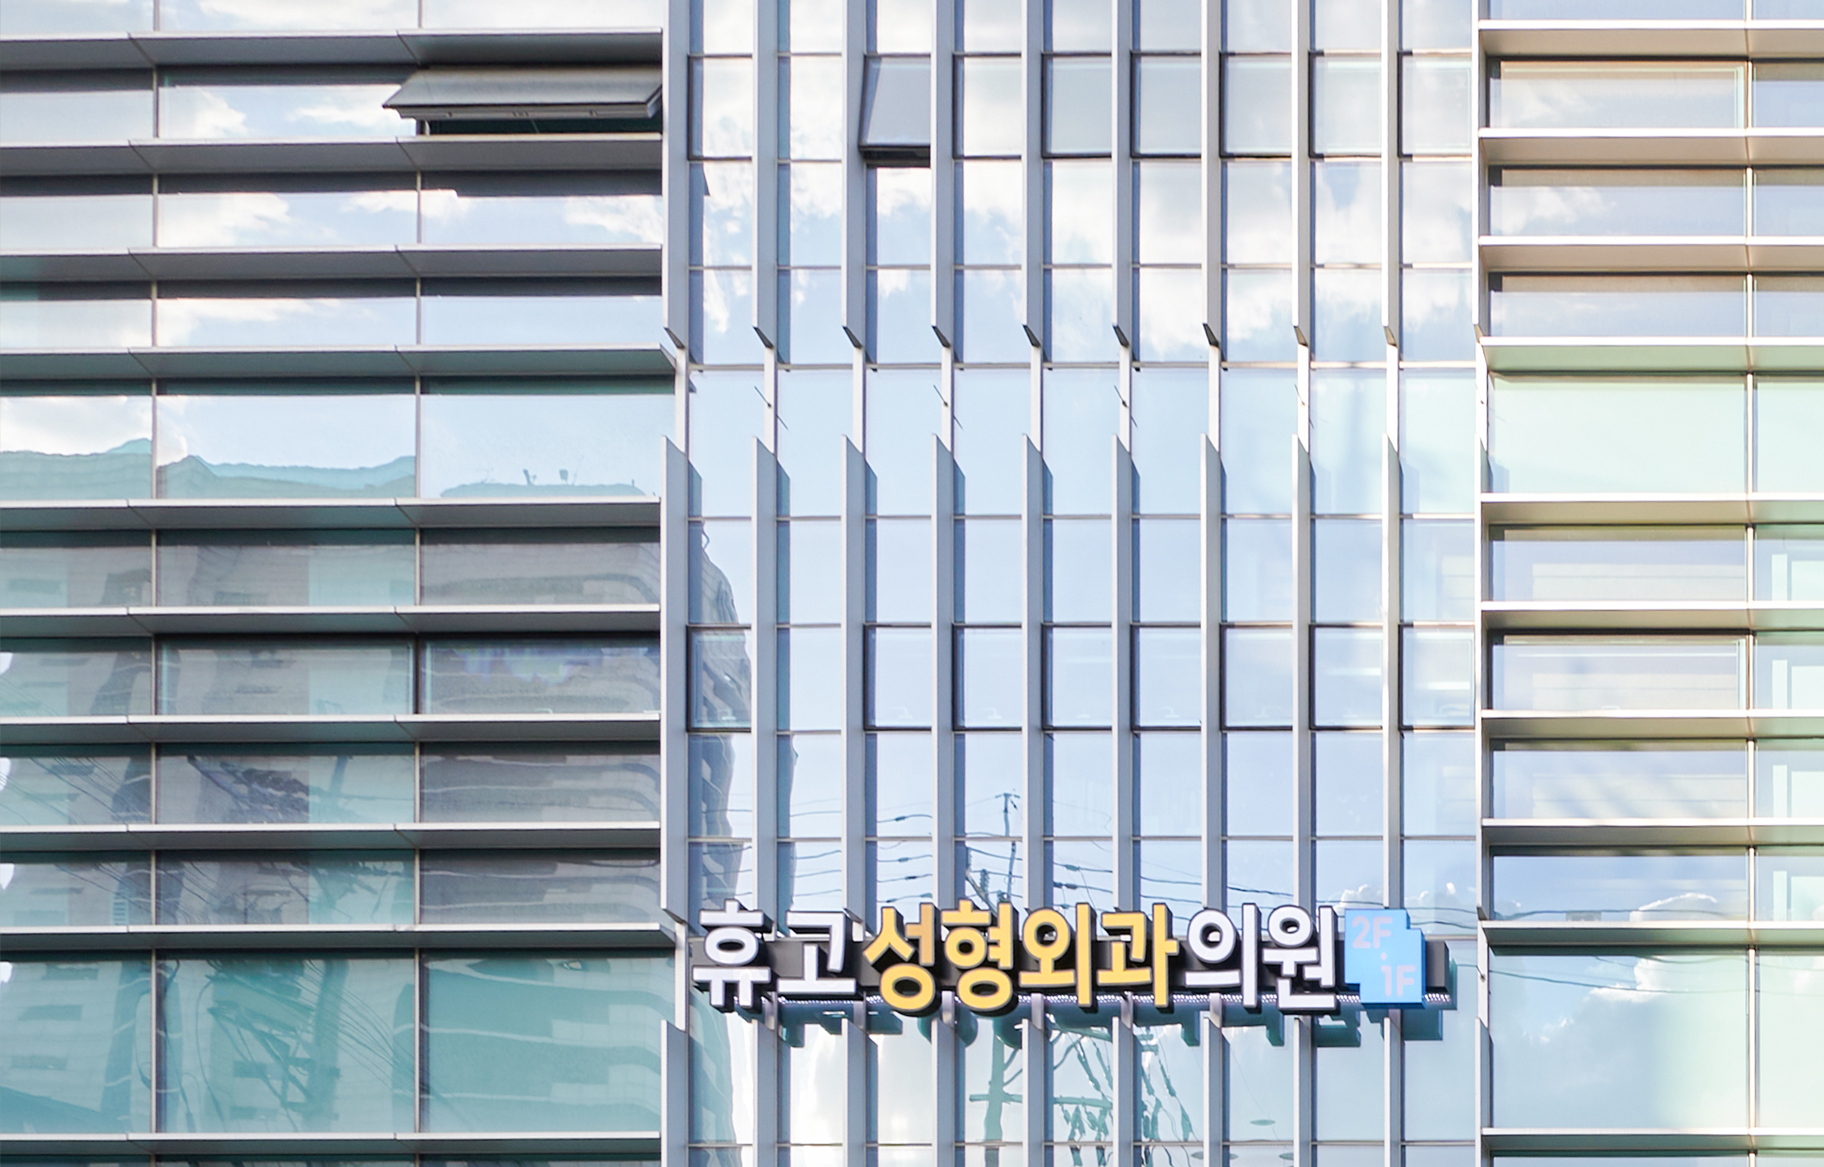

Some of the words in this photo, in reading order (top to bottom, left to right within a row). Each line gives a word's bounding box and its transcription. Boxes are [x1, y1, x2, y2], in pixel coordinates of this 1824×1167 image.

[1351, 918, 1393, 950] 2F
[693, 900, 1336, 1013] 휴고성형외과의원
[1380, 964, 1417, 995] 1F
